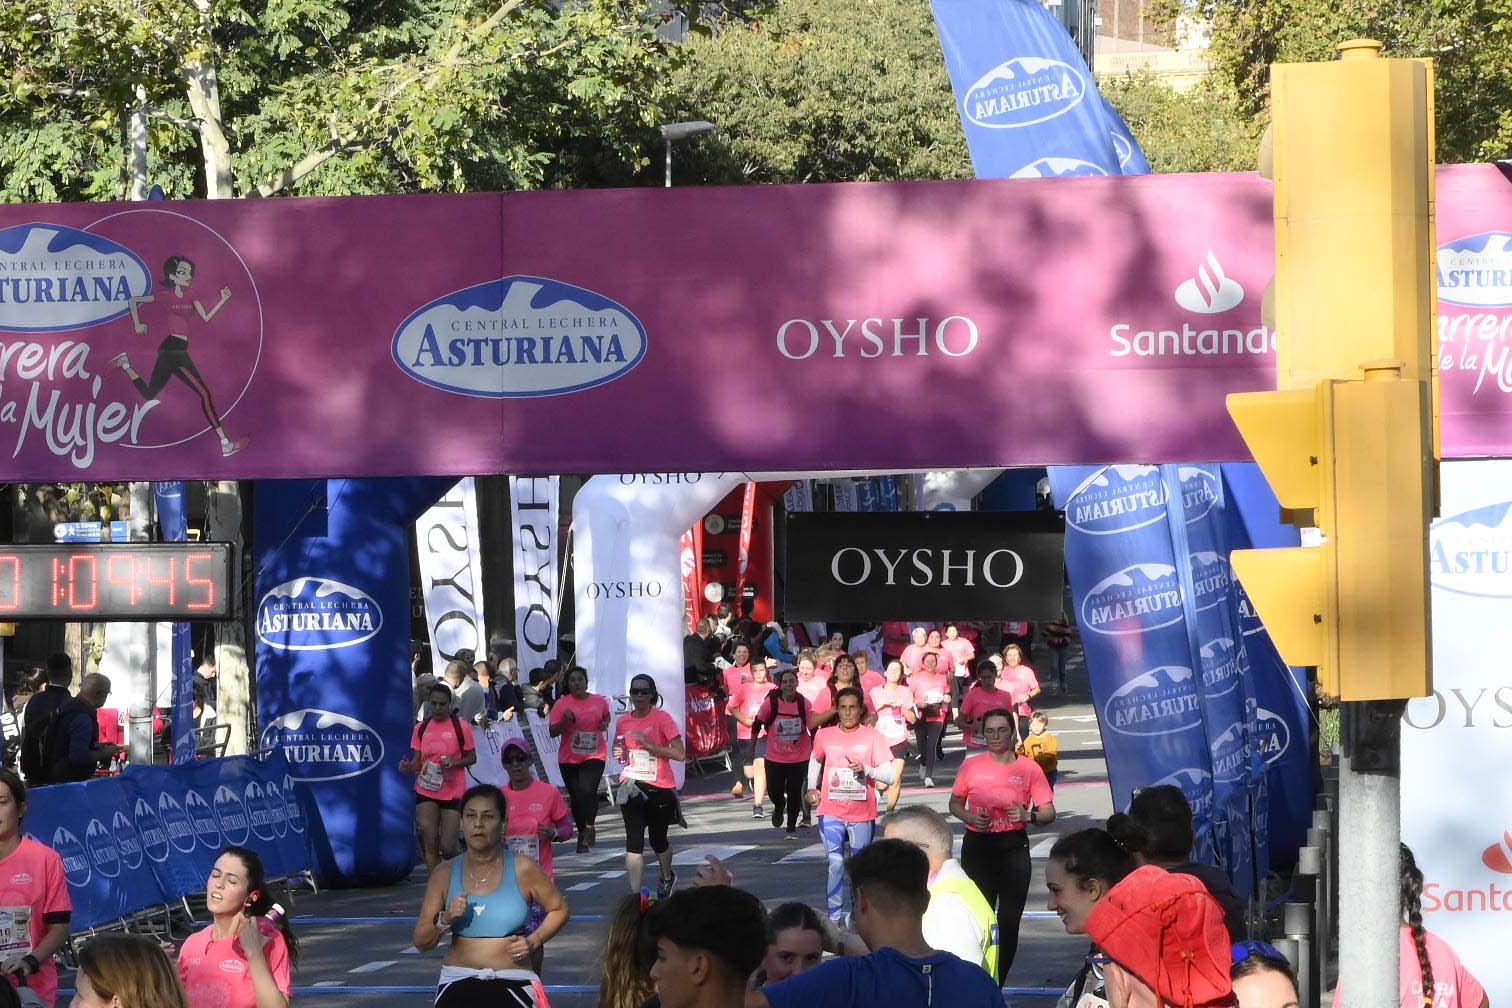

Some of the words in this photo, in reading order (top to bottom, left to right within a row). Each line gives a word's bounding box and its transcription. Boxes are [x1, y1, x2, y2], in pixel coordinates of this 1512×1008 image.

[54, 257, 128, 272] LECHERA
[449, 316, 530, 333] CENTRAL
[536, 315, 621, 330] LECHERA
[410, 322, 628, 369] ASTURIANA
[775, 314, 980, 361] OYSHO
[1109, 322, 1277, 357] Santand
[1459, 343, 1478, 370] la
[11, 374, 163, 469] Mujer
[619, 472, 702, 485] OYSHO
[830, 547, 1025, 588] OYSHO
[586, 580, 663, 601] OYSHO
[273, 602, 318, 612] CENTRAL
[320, 601, 370, 611] LECHERA
[260, 607, 375, 635] ASTURIANA
[320, 733, 372, 742] LECHERA
[282, 743, 375, 765] TURIANA
